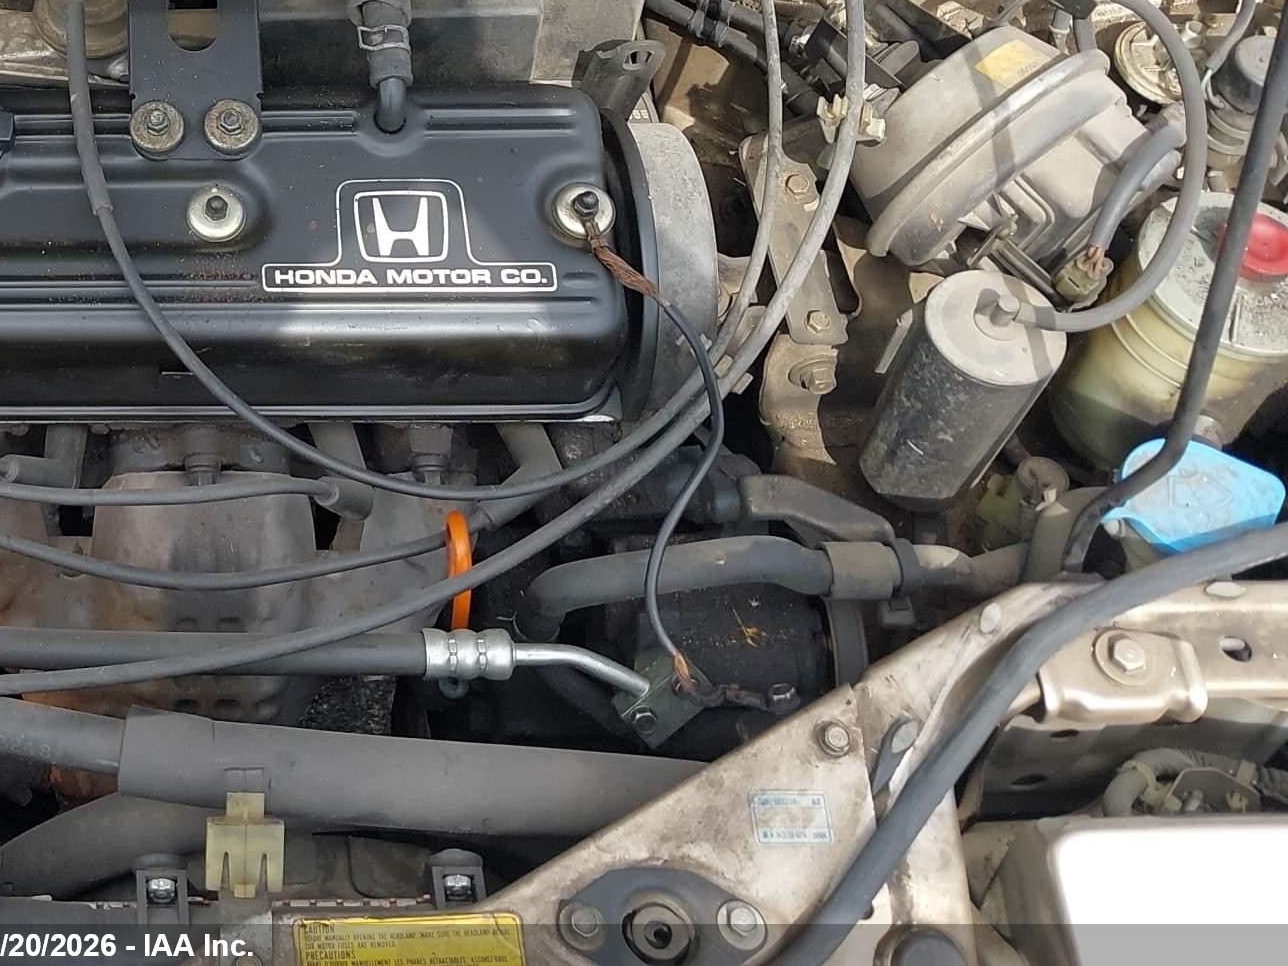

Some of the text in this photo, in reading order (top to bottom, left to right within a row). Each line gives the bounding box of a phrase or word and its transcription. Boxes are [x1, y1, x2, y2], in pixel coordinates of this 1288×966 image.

[275, 269, 548, 285] HONDA MOTOR CO.
[305, 923, 335, 934] CAUTION
